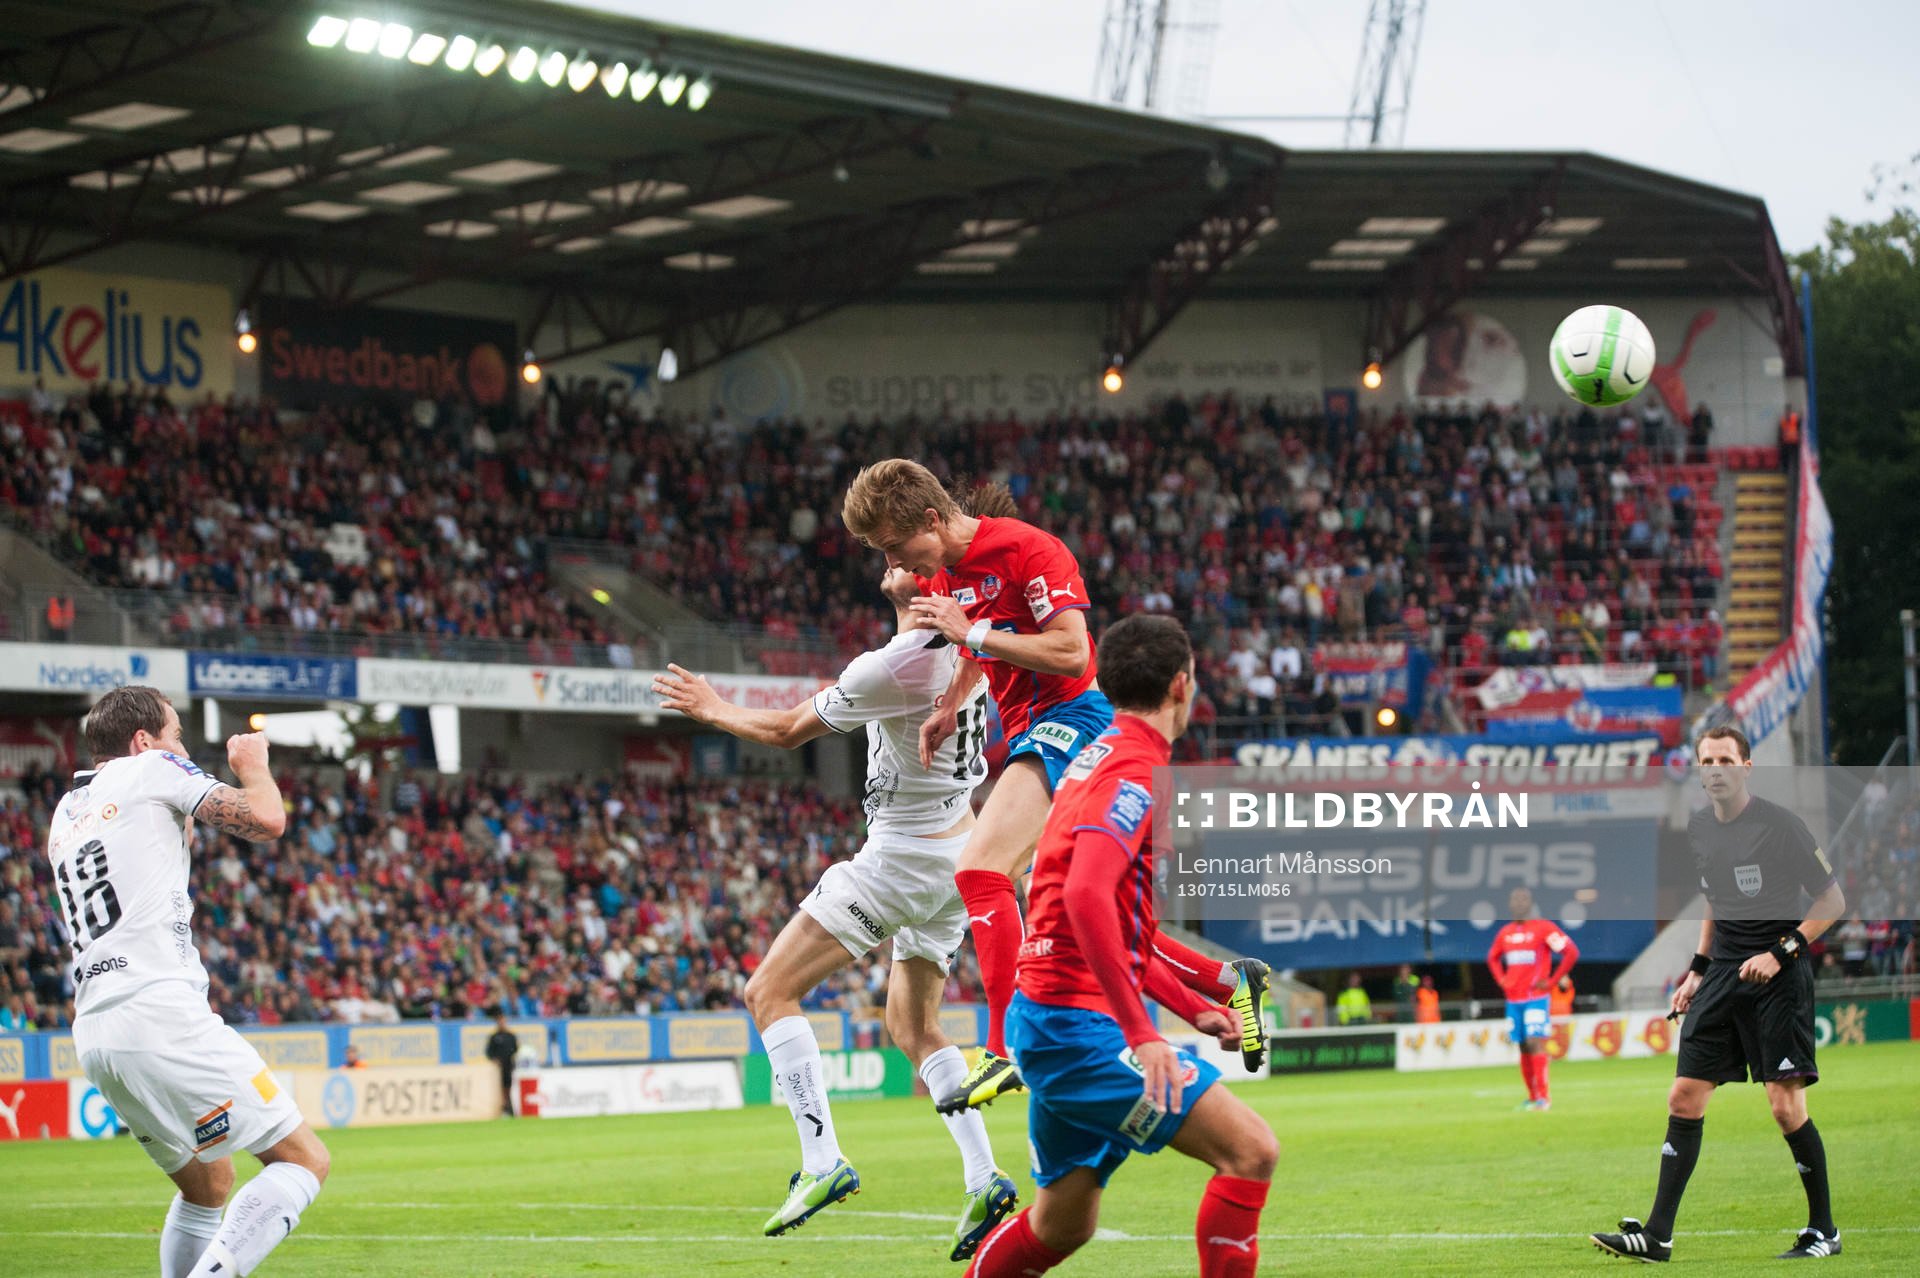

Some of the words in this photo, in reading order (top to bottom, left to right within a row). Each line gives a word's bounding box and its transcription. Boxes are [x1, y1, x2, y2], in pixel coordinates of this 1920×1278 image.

[0, 280, 204, 388] Akelius
[271, 331, 462, 394] Swedbank
[826, 370, 1008, 412] support
[556, 673, 656, 705] Scandline
[1031, 726, 1074, 744] SOLID
[1234, 739, 1391, 784] SKÅNES
[1462, 737, 1660, 786] STOLTHET
[1740, 875, 1759, 886] FIFA
[1261, 897, 1448, 943] BANK
[363, 1075, 472, 1116] POSTEN!
[788, 1073, 810, 1110] VIKING
[196, 1117, 229, 1141] ALWEX
